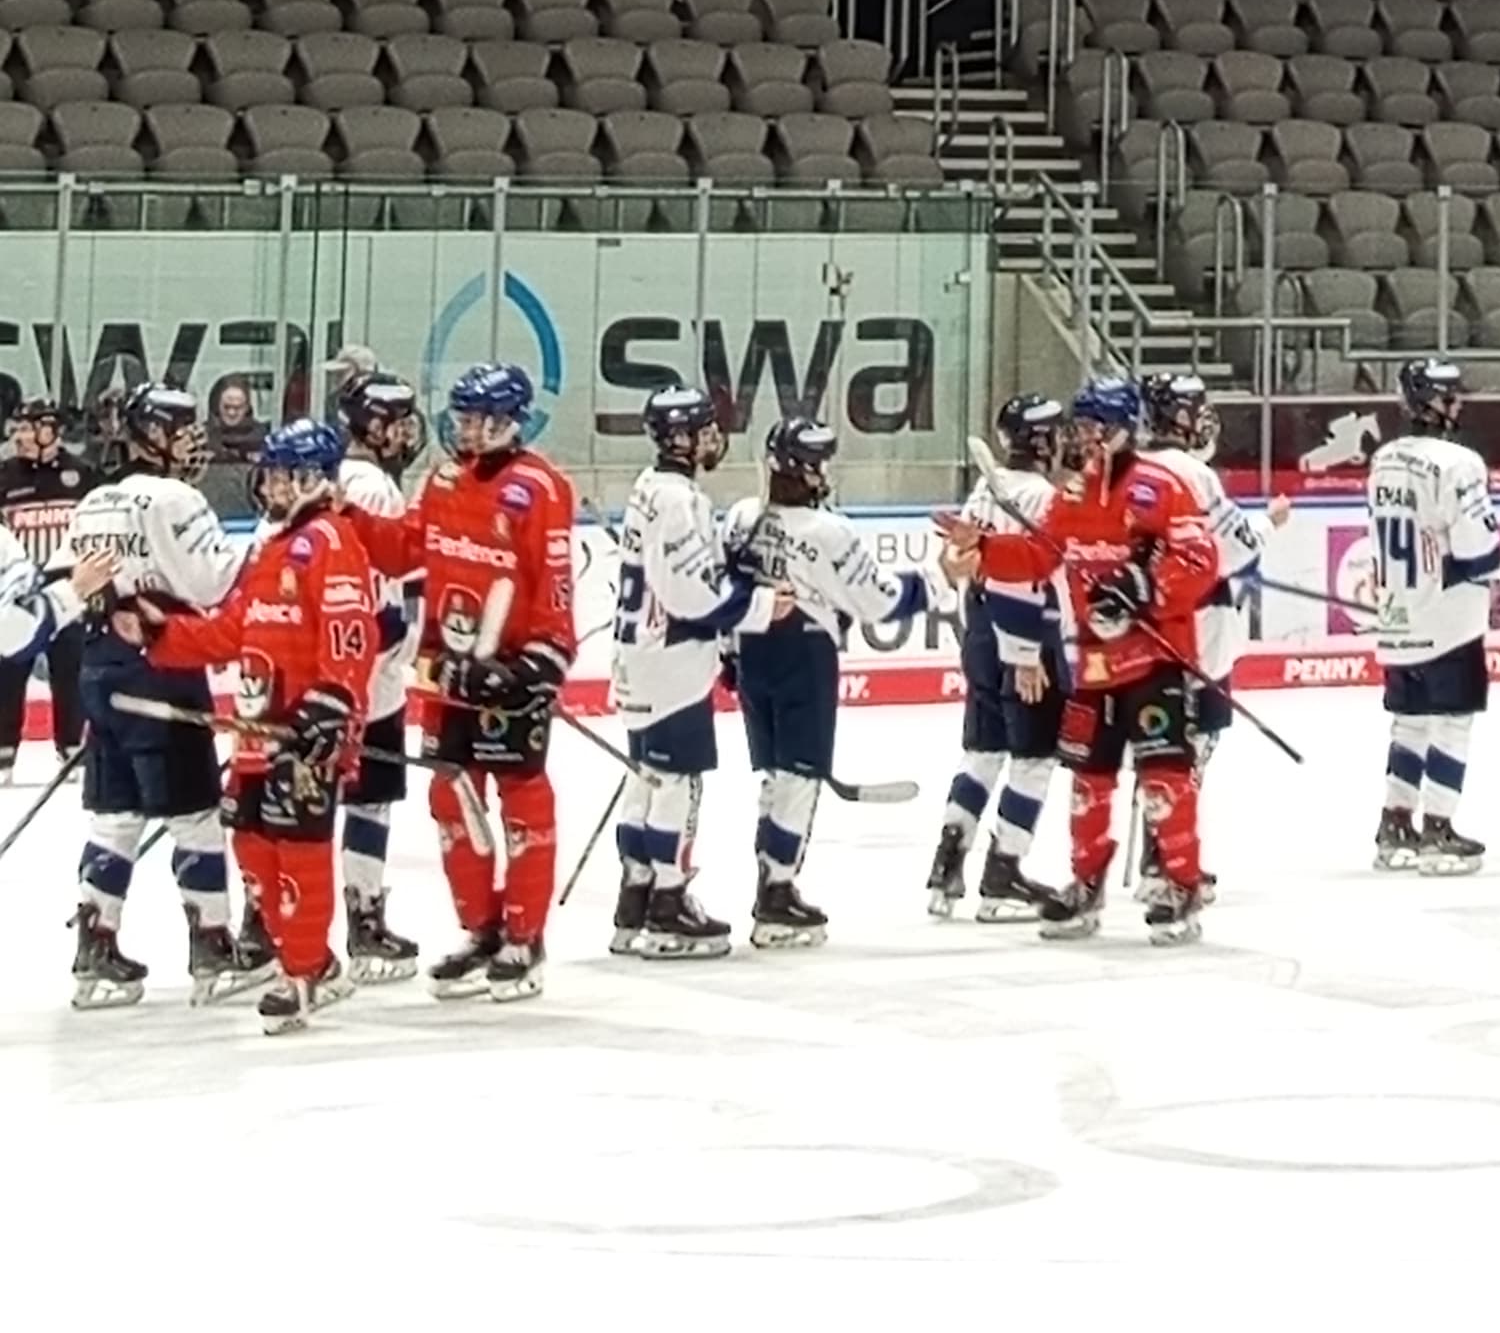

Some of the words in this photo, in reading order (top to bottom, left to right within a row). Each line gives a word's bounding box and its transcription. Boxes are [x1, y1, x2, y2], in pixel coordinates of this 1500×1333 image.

[0, 319, 312, 431] wa
[596, 316, 936, 435] swa
[329, 620, 366, 661] 14
